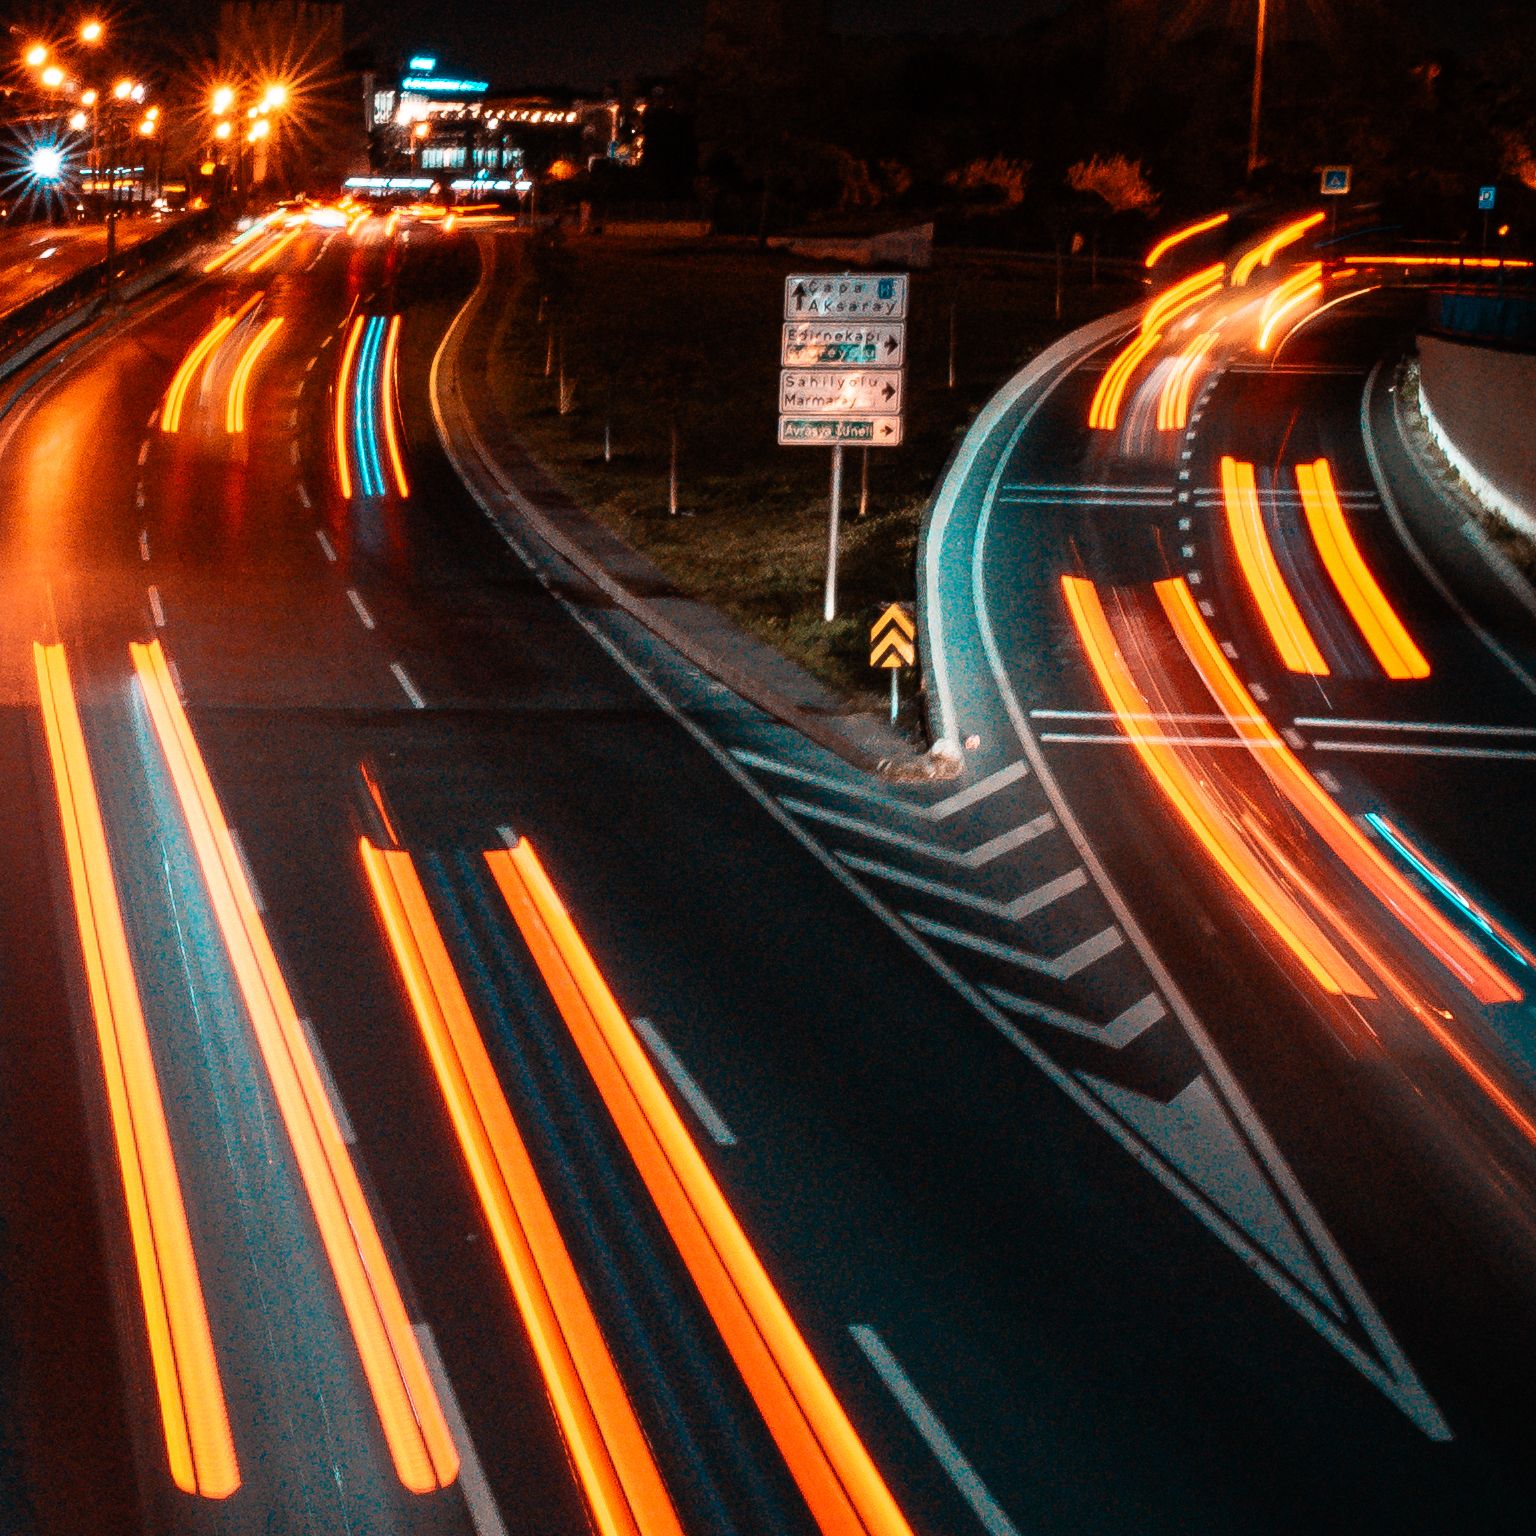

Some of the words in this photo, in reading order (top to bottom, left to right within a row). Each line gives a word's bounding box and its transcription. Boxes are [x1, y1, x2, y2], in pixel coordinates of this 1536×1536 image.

[808, 299, 898, 315] Aksaray
[785, 375, 878, 390] Sahilyolu
[784, 394, 856, 409] Marmaray
